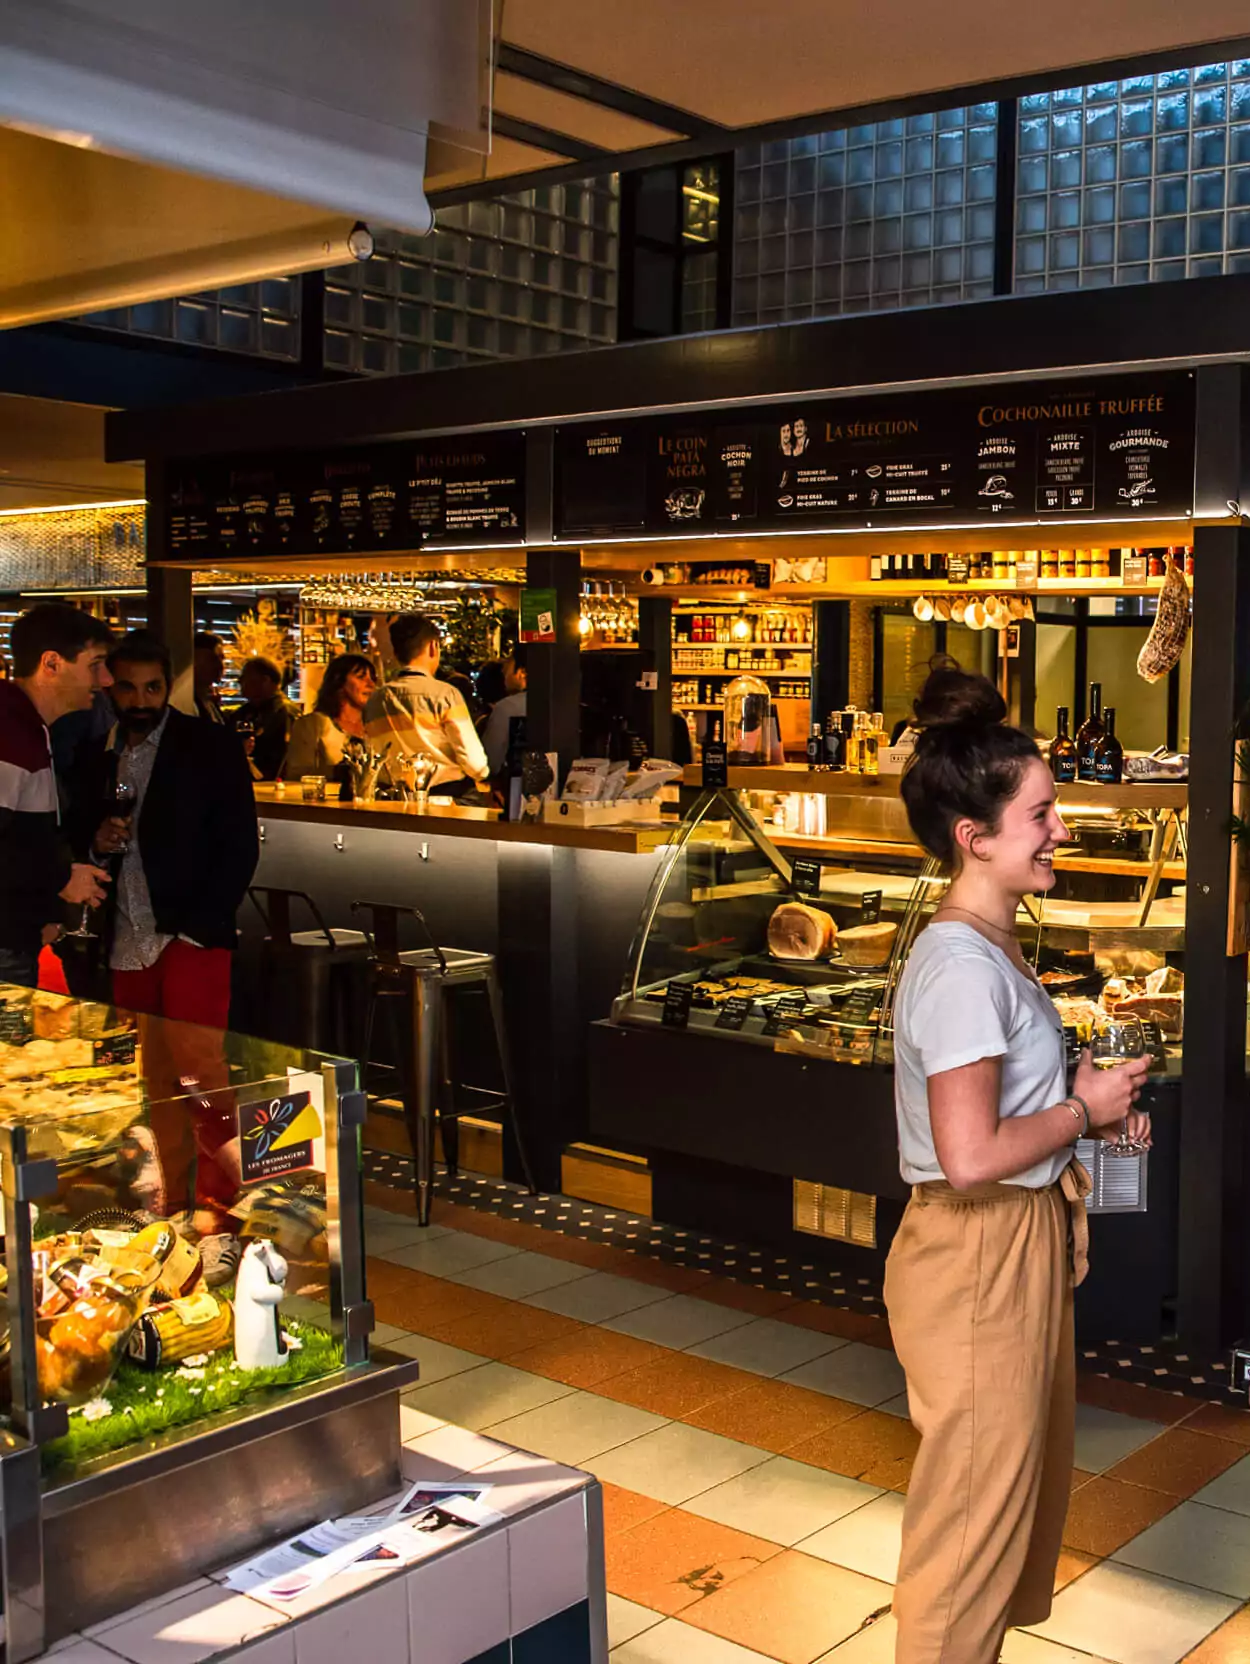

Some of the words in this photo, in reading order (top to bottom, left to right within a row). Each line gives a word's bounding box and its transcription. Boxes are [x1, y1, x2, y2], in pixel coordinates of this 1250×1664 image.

[977, 401, 1091, 427] COCHONAILLE
[1098, 394, 1165, 416] TRUFFÉE
[846, 418, 920, 438] SÉLECTION
[1127, 428, 1151, 436] ARDOISE
[676, 436, 708, 452] COIN
[1053, 434, 1077, 442] ARDOISE
[1109, 437, 1170, 451] GOURMANDE
[977, 445, 1016, 457] JAMBON
[1050, 441, 1080, 452] MIXTE
[673, 451, 700, 465] PATA
[721, 452, 752, 461] COCHON
[727, 459, 746, 468] NOIR
[666, 463, 707, 478] NEGRA
[247, 1162, 260, 1170] LES
[262, 1150, 306, 1166] FROMAGERS
[271, 1162, 292, 1172] FRANCE
